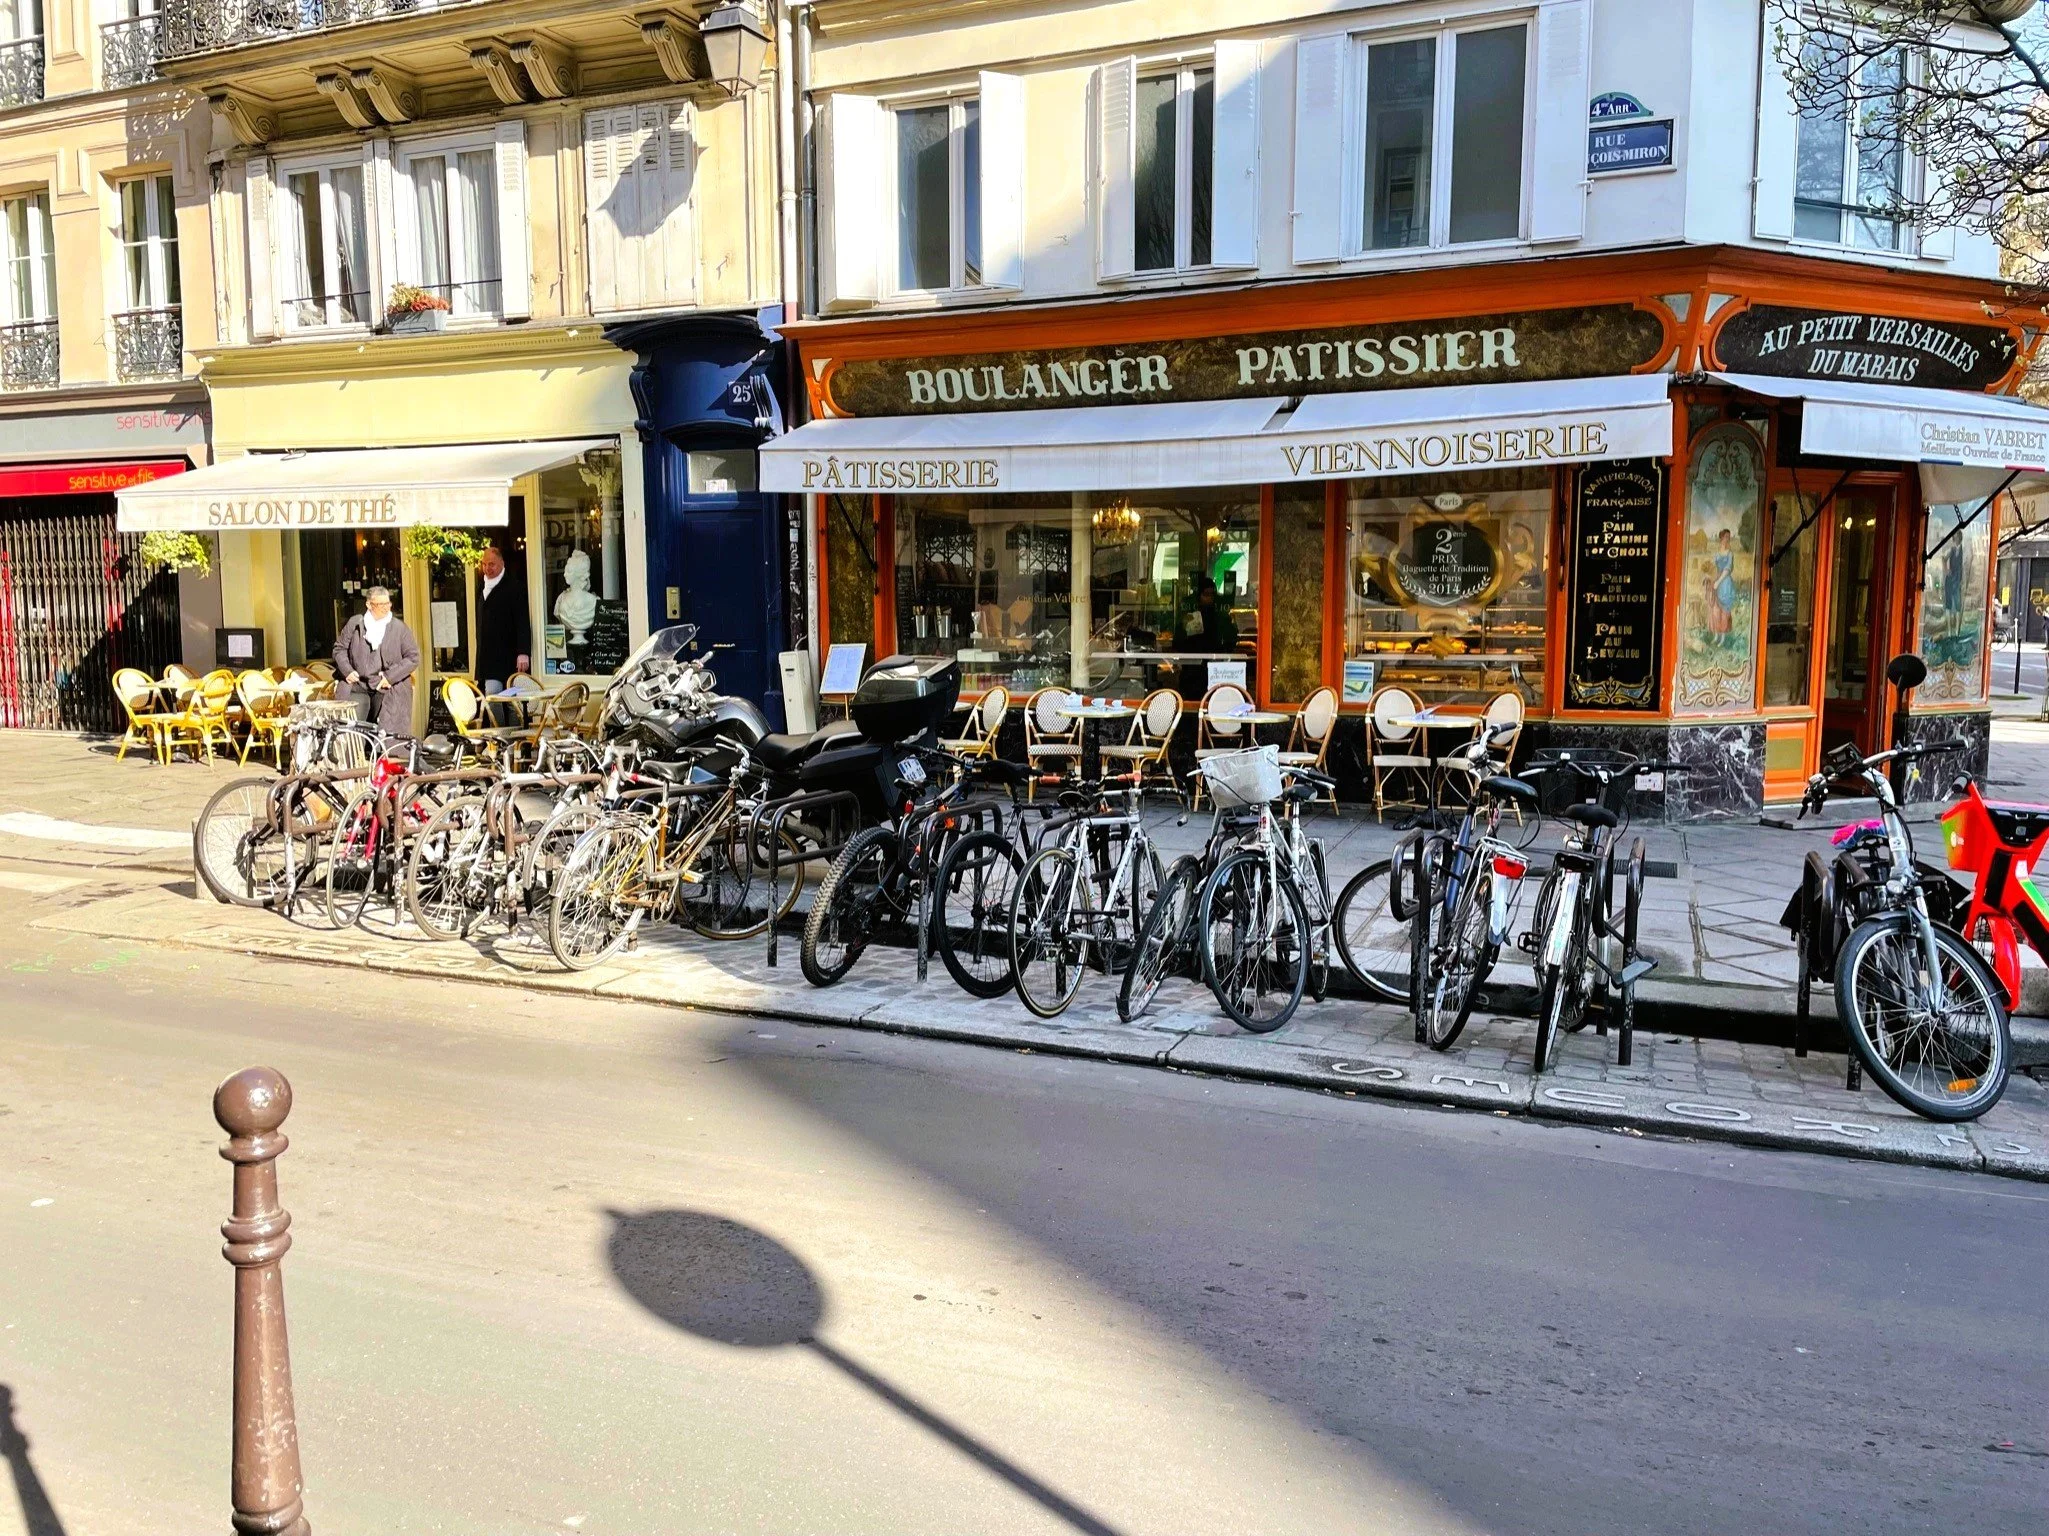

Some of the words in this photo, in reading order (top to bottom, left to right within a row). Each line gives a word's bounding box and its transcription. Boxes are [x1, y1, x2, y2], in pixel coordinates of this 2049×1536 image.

[1594, 133, 1626, 148] RUE
[1588, 145, 1668, 167] ÇOIS-MIRON
[1758, 324, 1793, 357] AU
[1797, 315, 1863, 346] PETIT
[1866, 316, 1980, 373] VERSAILLES
[905, 354, 1173, 404] BOULANGER
[1235, 328, 1521, 386] PATISSIER
[1807, 348, 1842, 374] DU
[1837, 350, 1920, 382] MARAIS
[732, 384, 752, 403] 25
[116, 410, 181, 431] sensitive
[1920, 422, 1981, 444] Christian
[1984, 427, 2047, 450] VABRET
[1280, 421, 1609, 476] VIENNOISERIE
[1920, 441, 1961, 456] Meilleur
[1962, 445, 2000, 459] Ouvrier
[2000, 449, 2013, 460] de
[2013, 449, 2046, 463] France
[68, 471, 127, 490] sensitive
[801, 455, 999, 489] PÂTISSERIE
[1584, 472, 1655, 495] PANIFICATION
[208, 501, 293, 526] SALON
[298, 499, 335, 524] DE
[340, 493, 397, 524] THÉ
[1586, 497, 1652, 508] FRANÇAISE
[1402, 564, 1437, 574] Baguette
[1439, 564, 1451, 573] de
[1452, 564, 1489, 573] Tradition
[1431, 554, 1458, 564] PRIX
[1428, 583, 1461, 595] 2014
[1429, 574, 1439, 582] de
[1441, 574, 1462, 582] Paris
